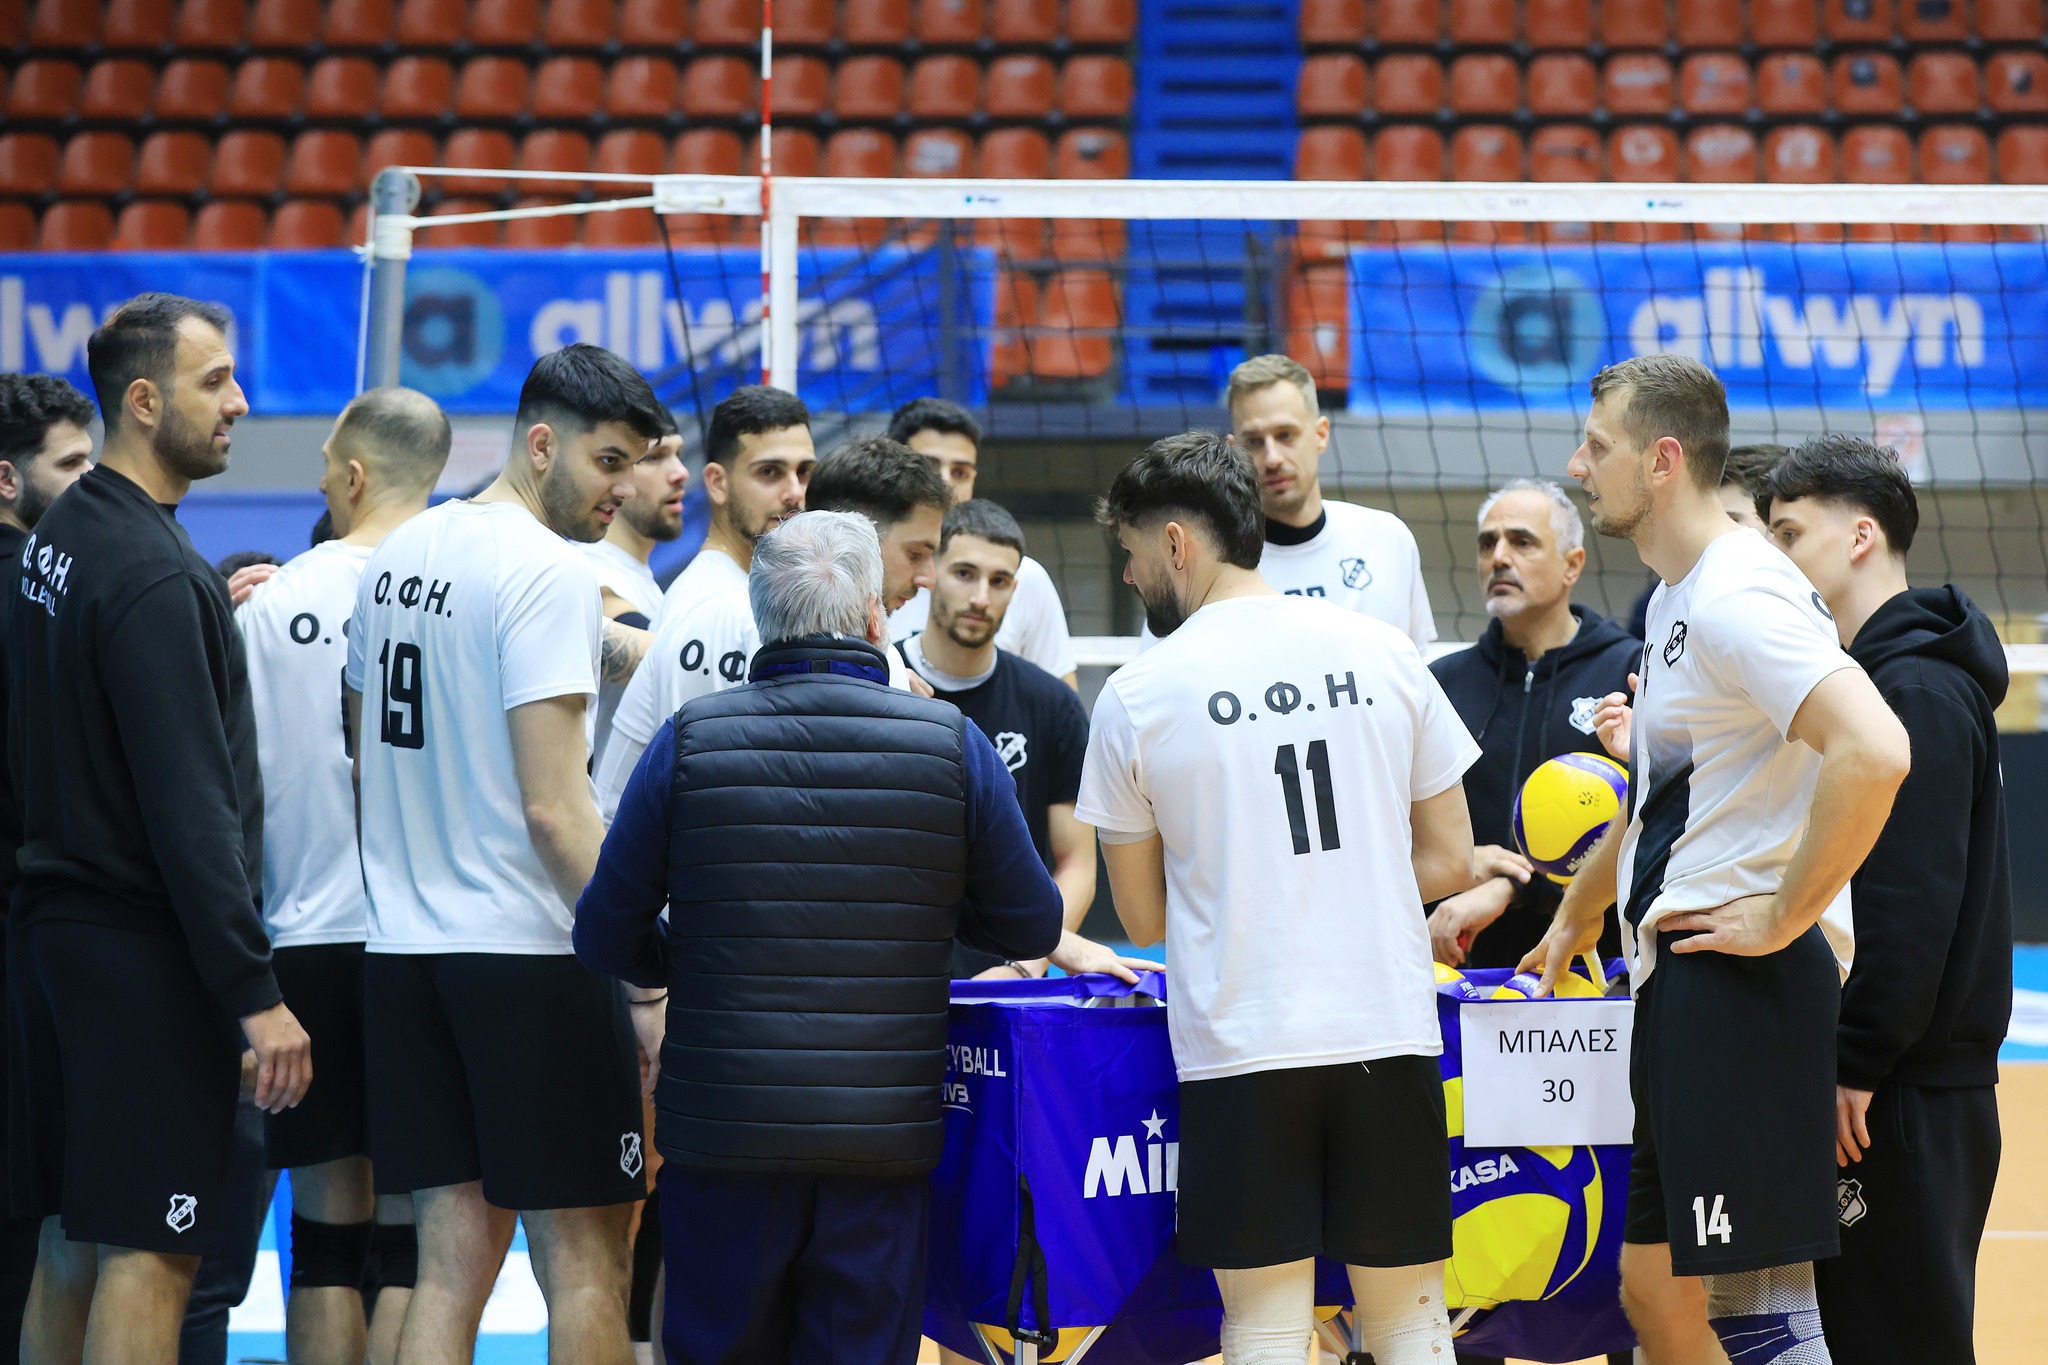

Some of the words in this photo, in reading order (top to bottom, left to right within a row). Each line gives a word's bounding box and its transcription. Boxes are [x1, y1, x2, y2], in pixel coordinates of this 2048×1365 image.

[1629, 267, 1985, 396] allwyn
[379, 638, 426, 750] 19
[1274, 738, 1342, 856] 11
[1499, 1028, 1618, 1054] ΜΠΑΛΕΣ
[941, 1082, 970, 1104] IVB
[1541, 1078, 1576, 1103] 30
[1692, 1194, 1733, 1247] 14
